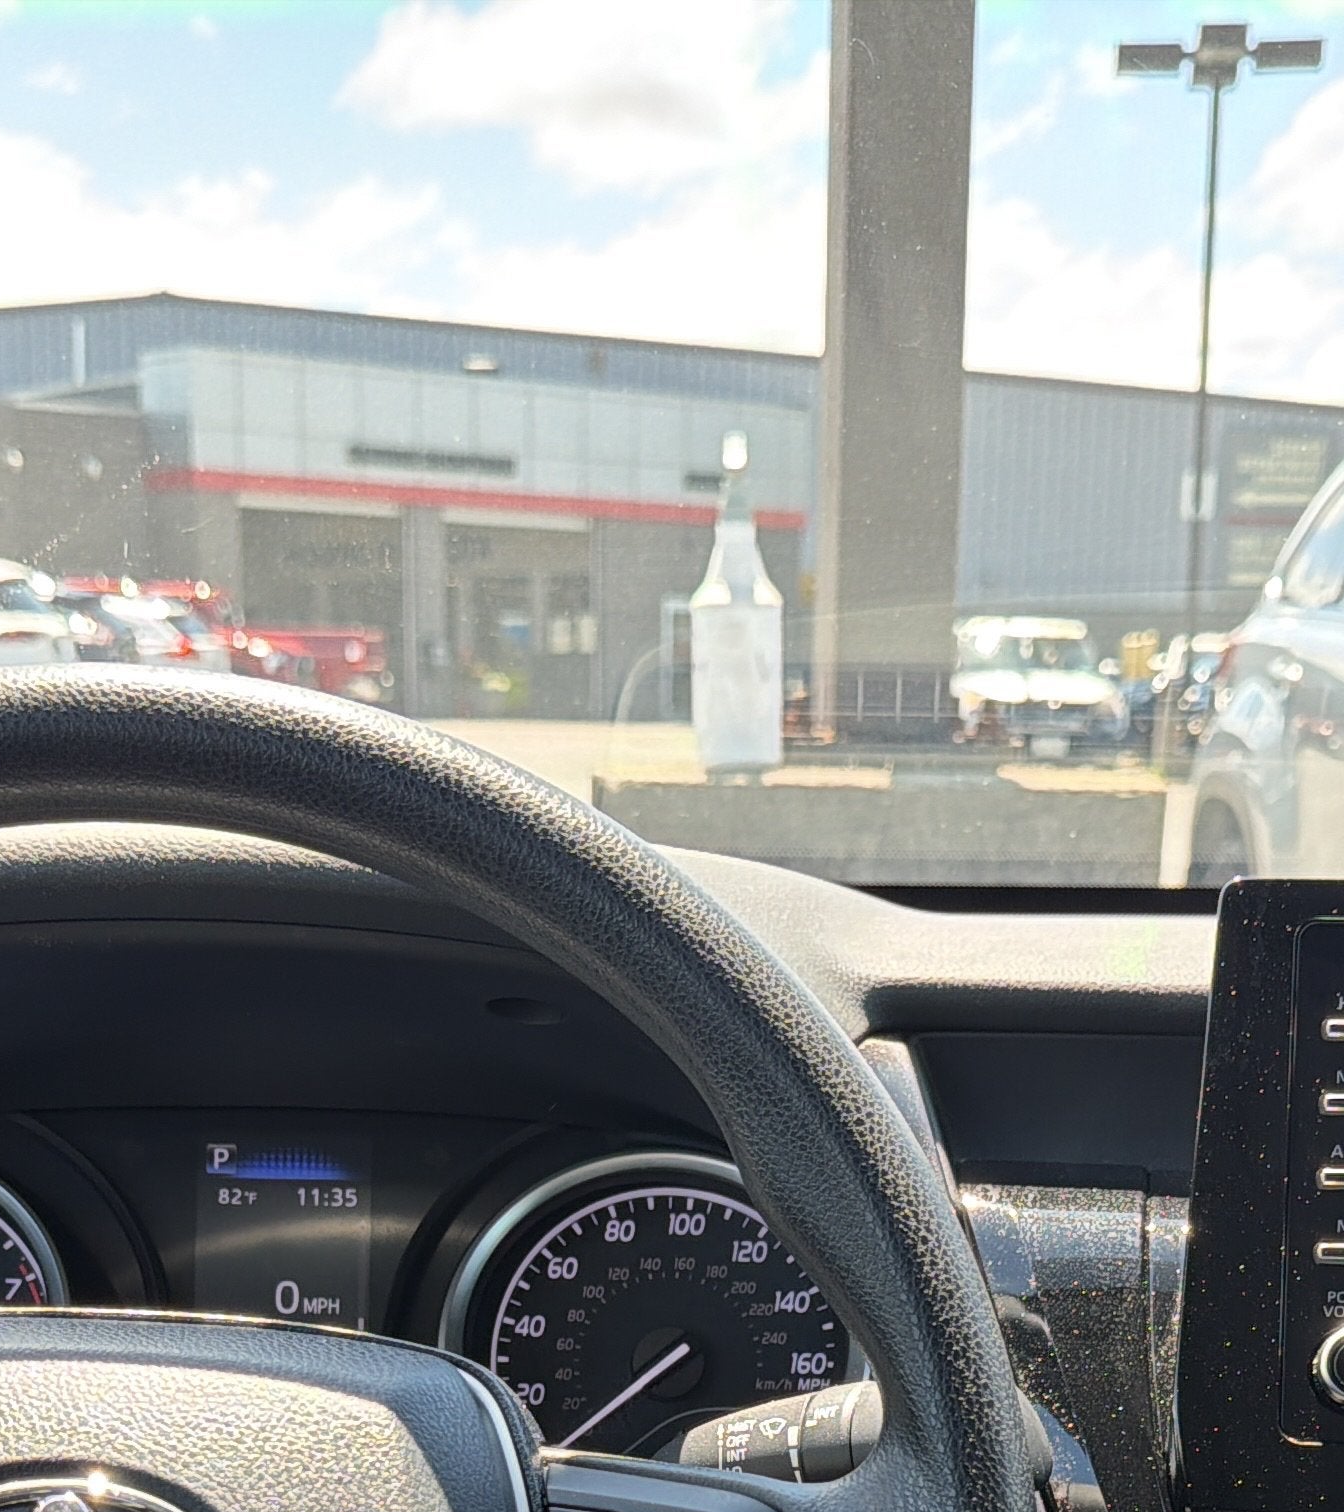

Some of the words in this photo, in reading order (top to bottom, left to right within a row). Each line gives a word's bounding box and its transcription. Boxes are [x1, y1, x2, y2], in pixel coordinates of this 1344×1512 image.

[212, 1147, 230, 1171] P
[297, 1187, 358, 1208] 11:35
[604, 1219, 635, 1243] 80
[668, 1213, 706, 1237] 100
[732, 1240, 768, 1264] 120
[547, 1256, 578, 1280] 60
[639, 1257, 662, 1272] 140
[674, 1257, 696, 1272] 160
[706, 1264, 728, 1279] 180
[608, 1266, 630, 1282] 120
[4, 1277, 22, 1300] 7
[582, 1285, 604, 1300] 100
[731, 1280, 757, 1296] 200
[275, 1280, 299, 1315] 0
[303, 1297, 340, 1315] MPH
[774, 1290, 810, 1315] 140
[567, 1308, 586, 1324] 80
[749, 1303, 774, 1317] 220
[514, 1315, 546, 1338] 40
[556, 1338, 574, 1352] 60
[761, 1331, 788, 1346] 240
[791, 1352, 827, 1375] 160
[555, 1367, 573, 1382] 40
[756, 1377, 793, 1391] km/h
[797, 1378, 831, 1391] MPH
[516, 1382, 545, 1406] 20
[726, 1449, 748, 1463] INT
